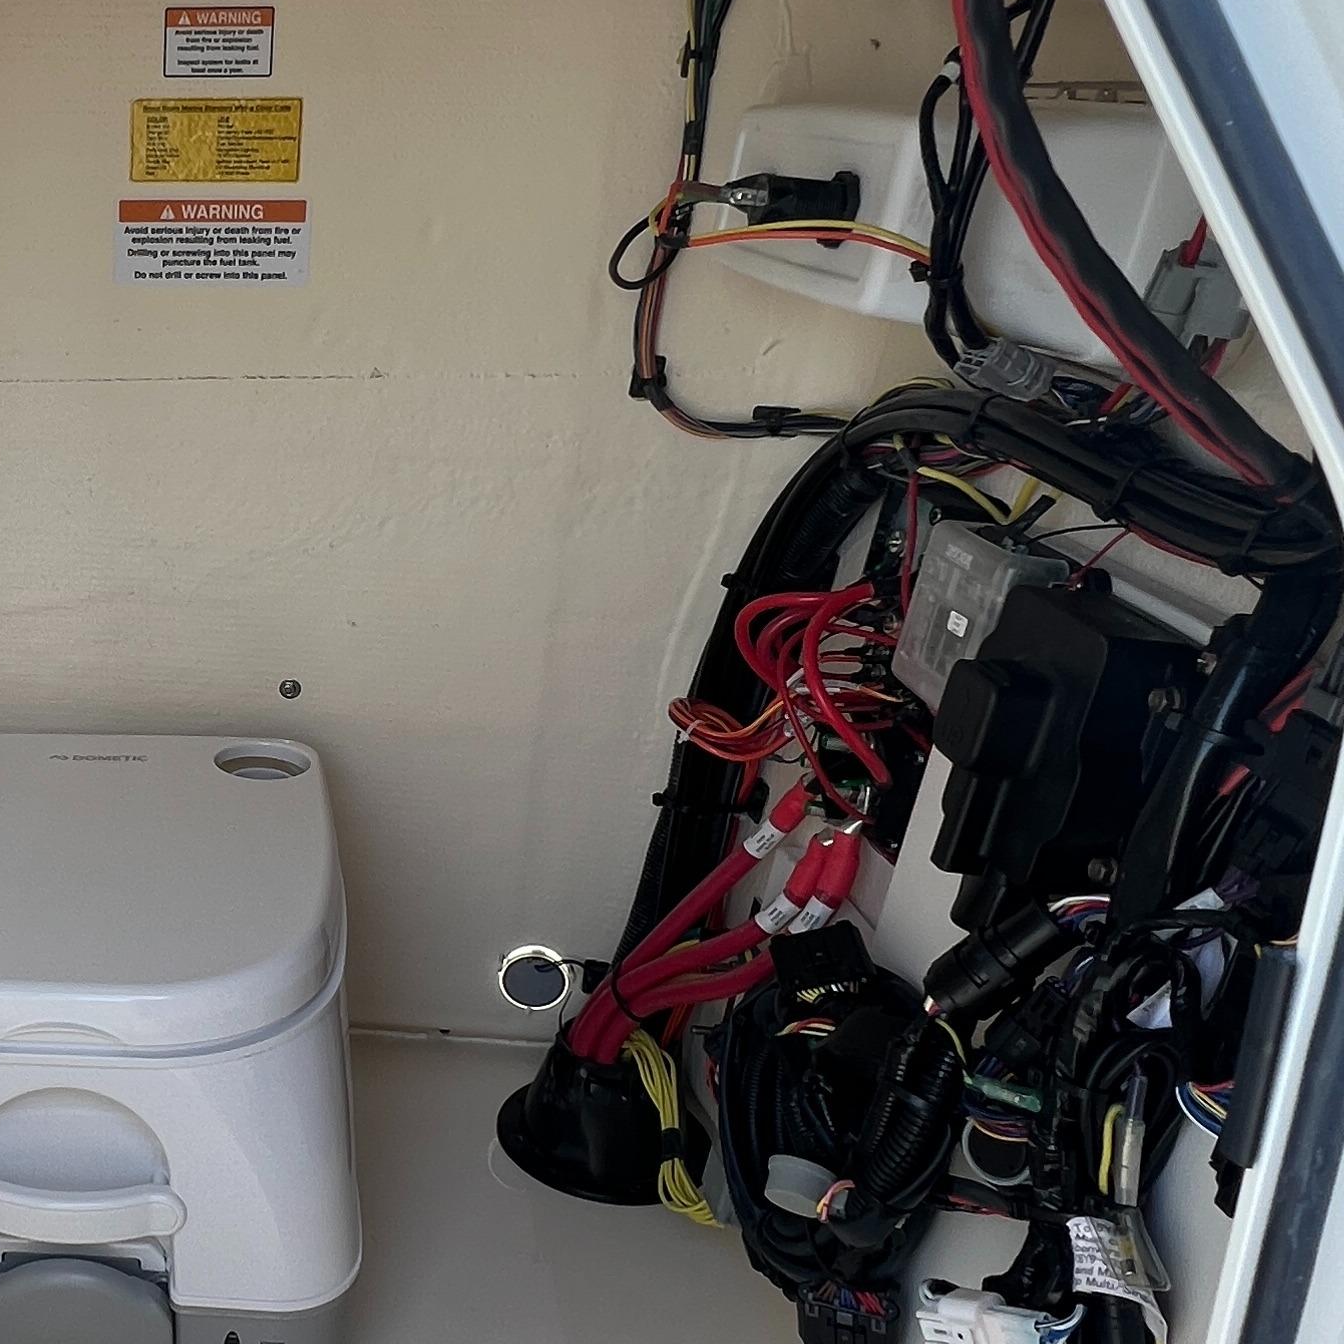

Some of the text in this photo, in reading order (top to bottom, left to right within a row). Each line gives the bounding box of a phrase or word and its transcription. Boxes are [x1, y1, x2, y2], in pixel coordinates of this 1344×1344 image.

[196, 11, 262, 24] WARNING
[181, 204, 264, 220] WARNING
[131, 236, 293, 245] explosion resulting from leaking fuel.
[127, 248, 158, 258] Drilling
[172, 248, 212, 258] screwing
[232, 249, 249, 257] this
[251, 249, 276, 259] panel
[277, 250, 297, 259] may
[162, 259, 201, 268] puncture
[134, 271, 147, 279] Do
[148, 271, 163, 279] not
[164, 271, 182, 279] drill
[196, 271, 222, 279] screw
[242, 271, 259, 279] this
[260, 271, 288, 281] panel.
